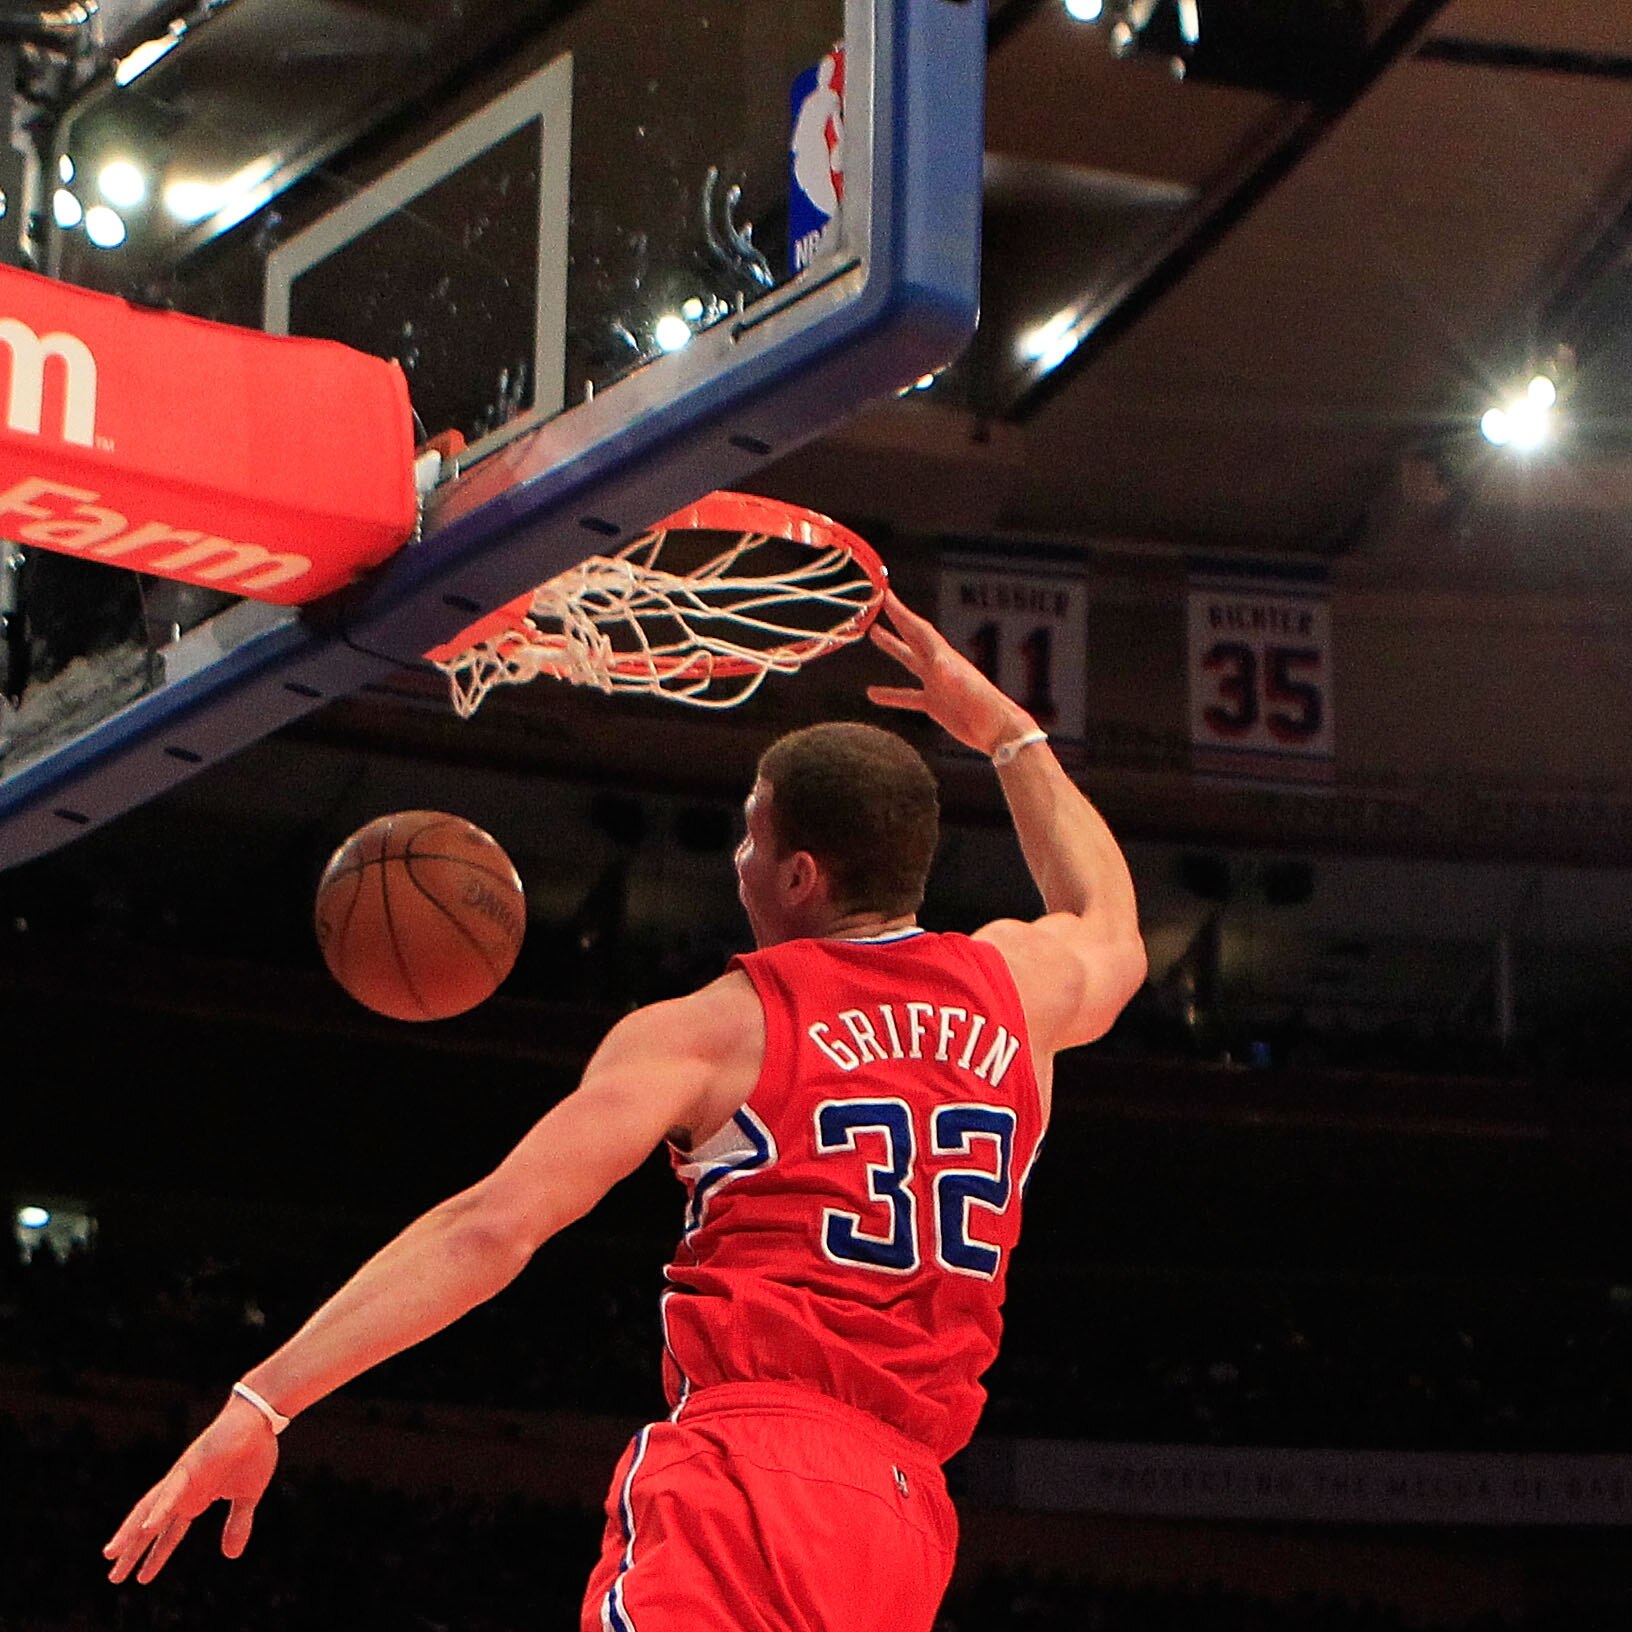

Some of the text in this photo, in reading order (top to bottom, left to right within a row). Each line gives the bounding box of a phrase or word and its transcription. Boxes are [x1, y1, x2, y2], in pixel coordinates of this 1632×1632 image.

[1201, 641, 1323, 745] 35
[808, 1002, 1021, 1088] GRIFFIN
[814, 1098, 1018, 1282] 32
